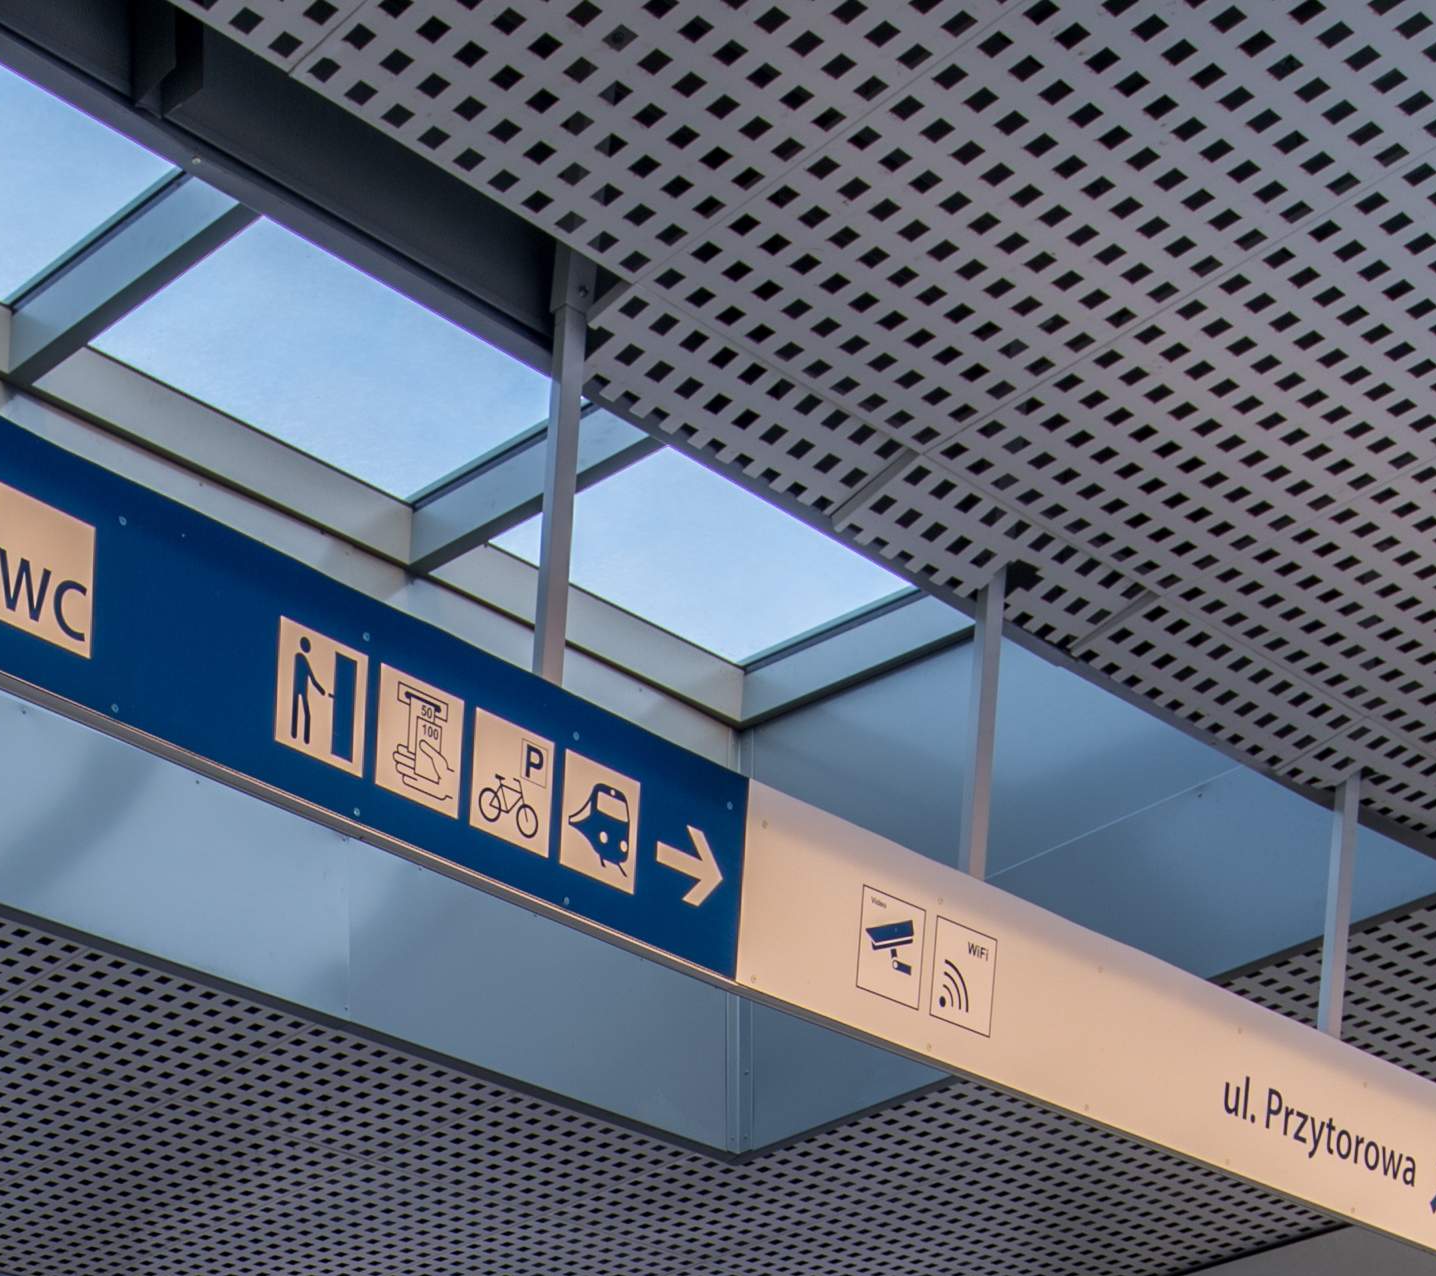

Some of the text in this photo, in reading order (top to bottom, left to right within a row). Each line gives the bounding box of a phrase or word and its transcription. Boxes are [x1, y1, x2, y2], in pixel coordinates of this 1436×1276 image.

[420, 704, 434, 720] 50
[421, 723, 440, 741] 100
[525, 743, 544, 778] P
[967, 941, 990, 962] WiFi
[1223, 1075, 1418, 1188] ul. Przytorowa
